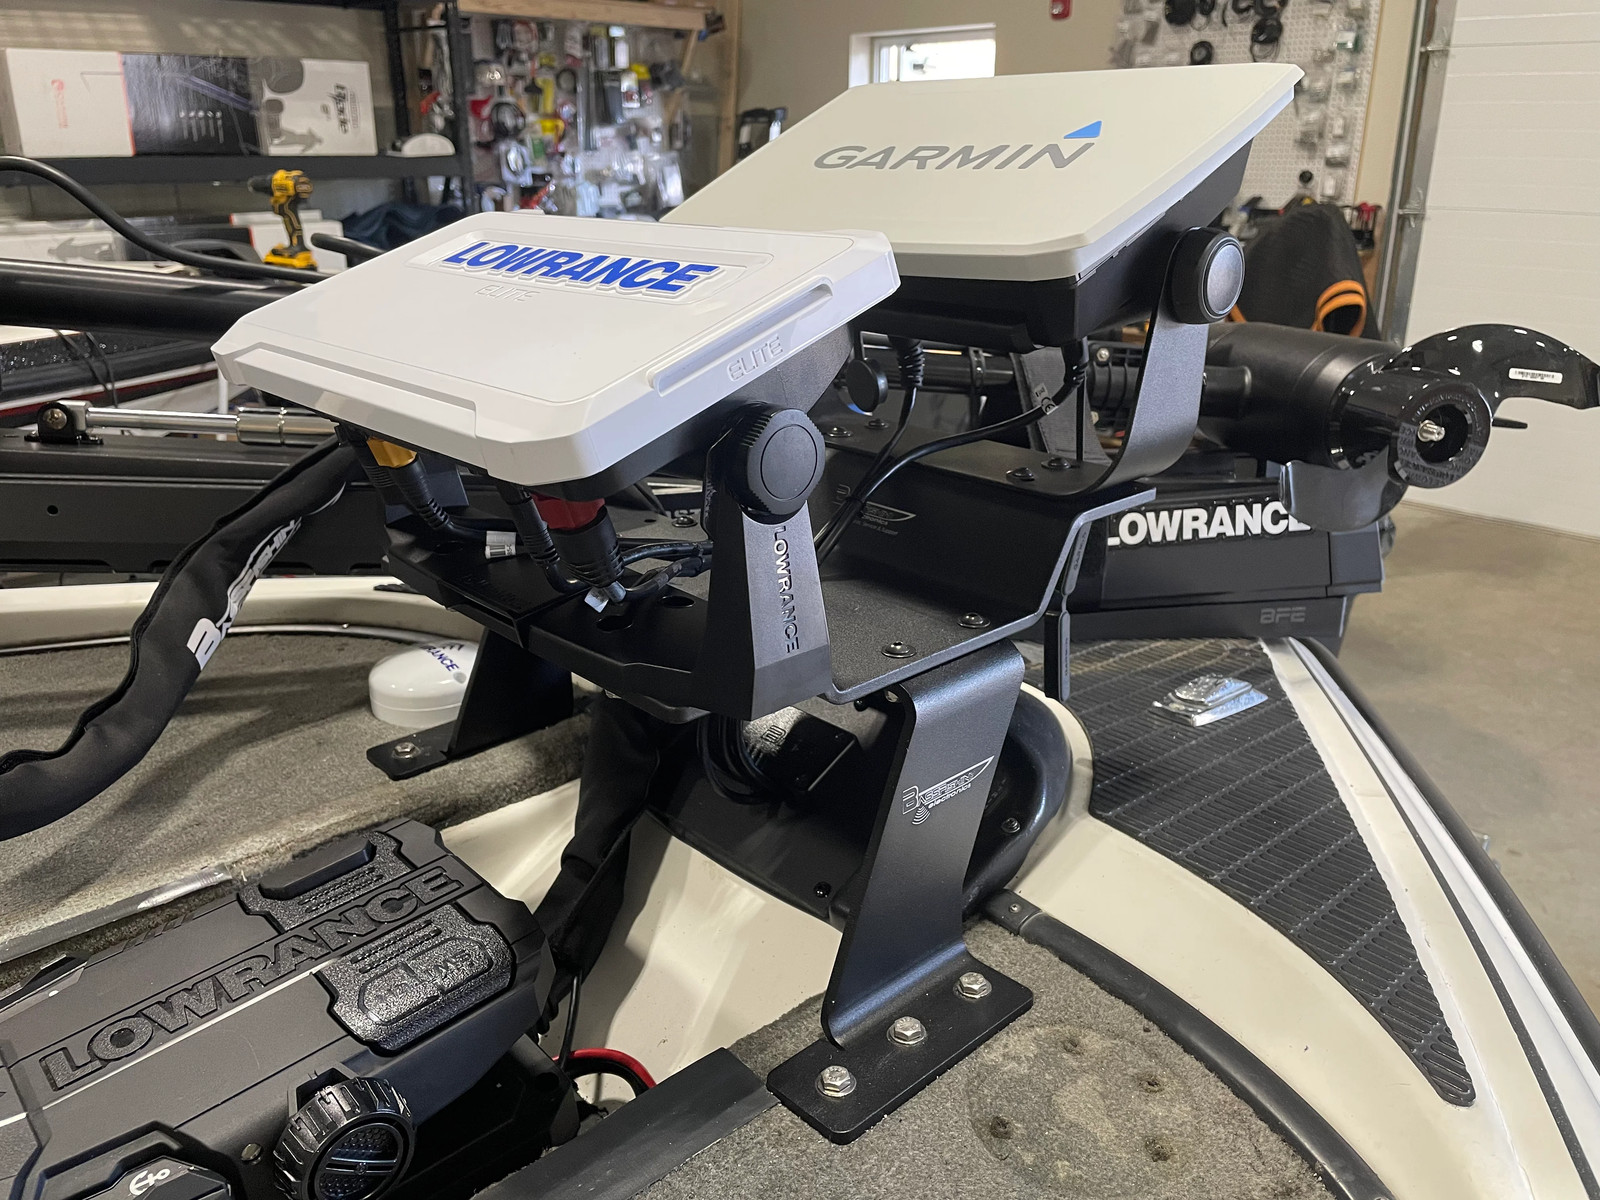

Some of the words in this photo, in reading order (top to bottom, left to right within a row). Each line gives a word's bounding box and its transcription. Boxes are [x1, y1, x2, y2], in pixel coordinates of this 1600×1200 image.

[813, 142, 1095, 170] GARMIN
[443, 241, 720, 292] LOWRANCE
[473, 284, 541, 302] ELITE
[726, 333, 784, 382] ELITE
[773, 525, 800, 654] LOWRANCE
[38, 865, 466, 1092] LOWRANCE
